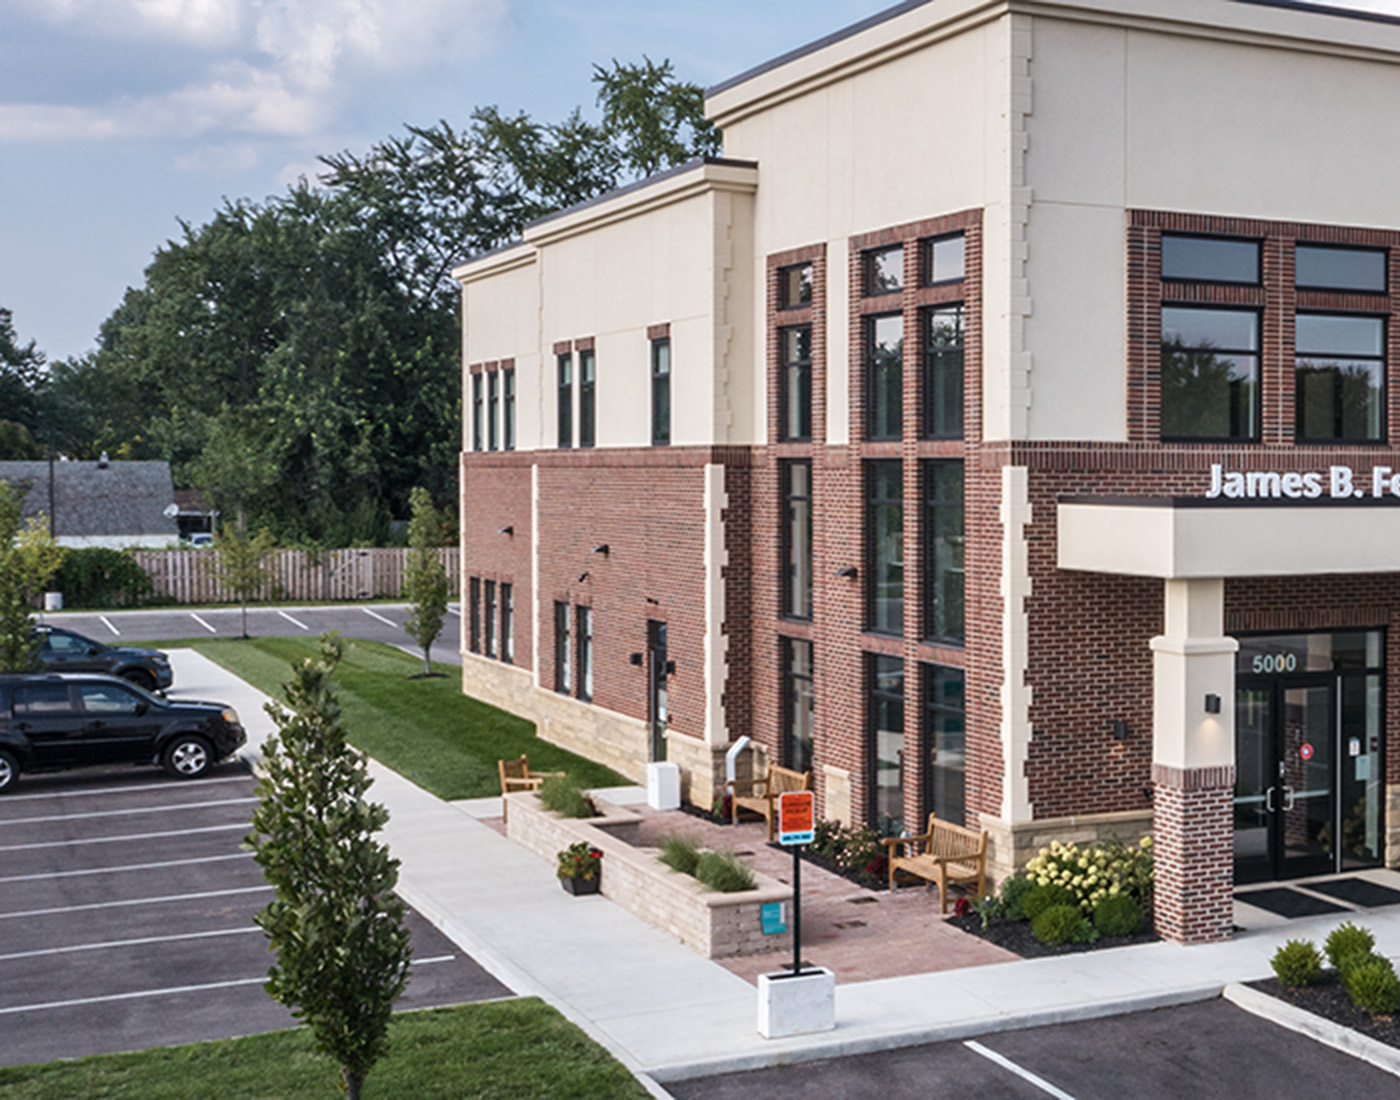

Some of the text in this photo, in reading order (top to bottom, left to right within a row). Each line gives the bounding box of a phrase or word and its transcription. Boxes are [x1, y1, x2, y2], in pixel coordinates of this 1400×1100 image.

[1206, 464, 1322, 499] James
[1329, 466, 1364, 499] B.
[1252, 653, 1297, 674] 5000
